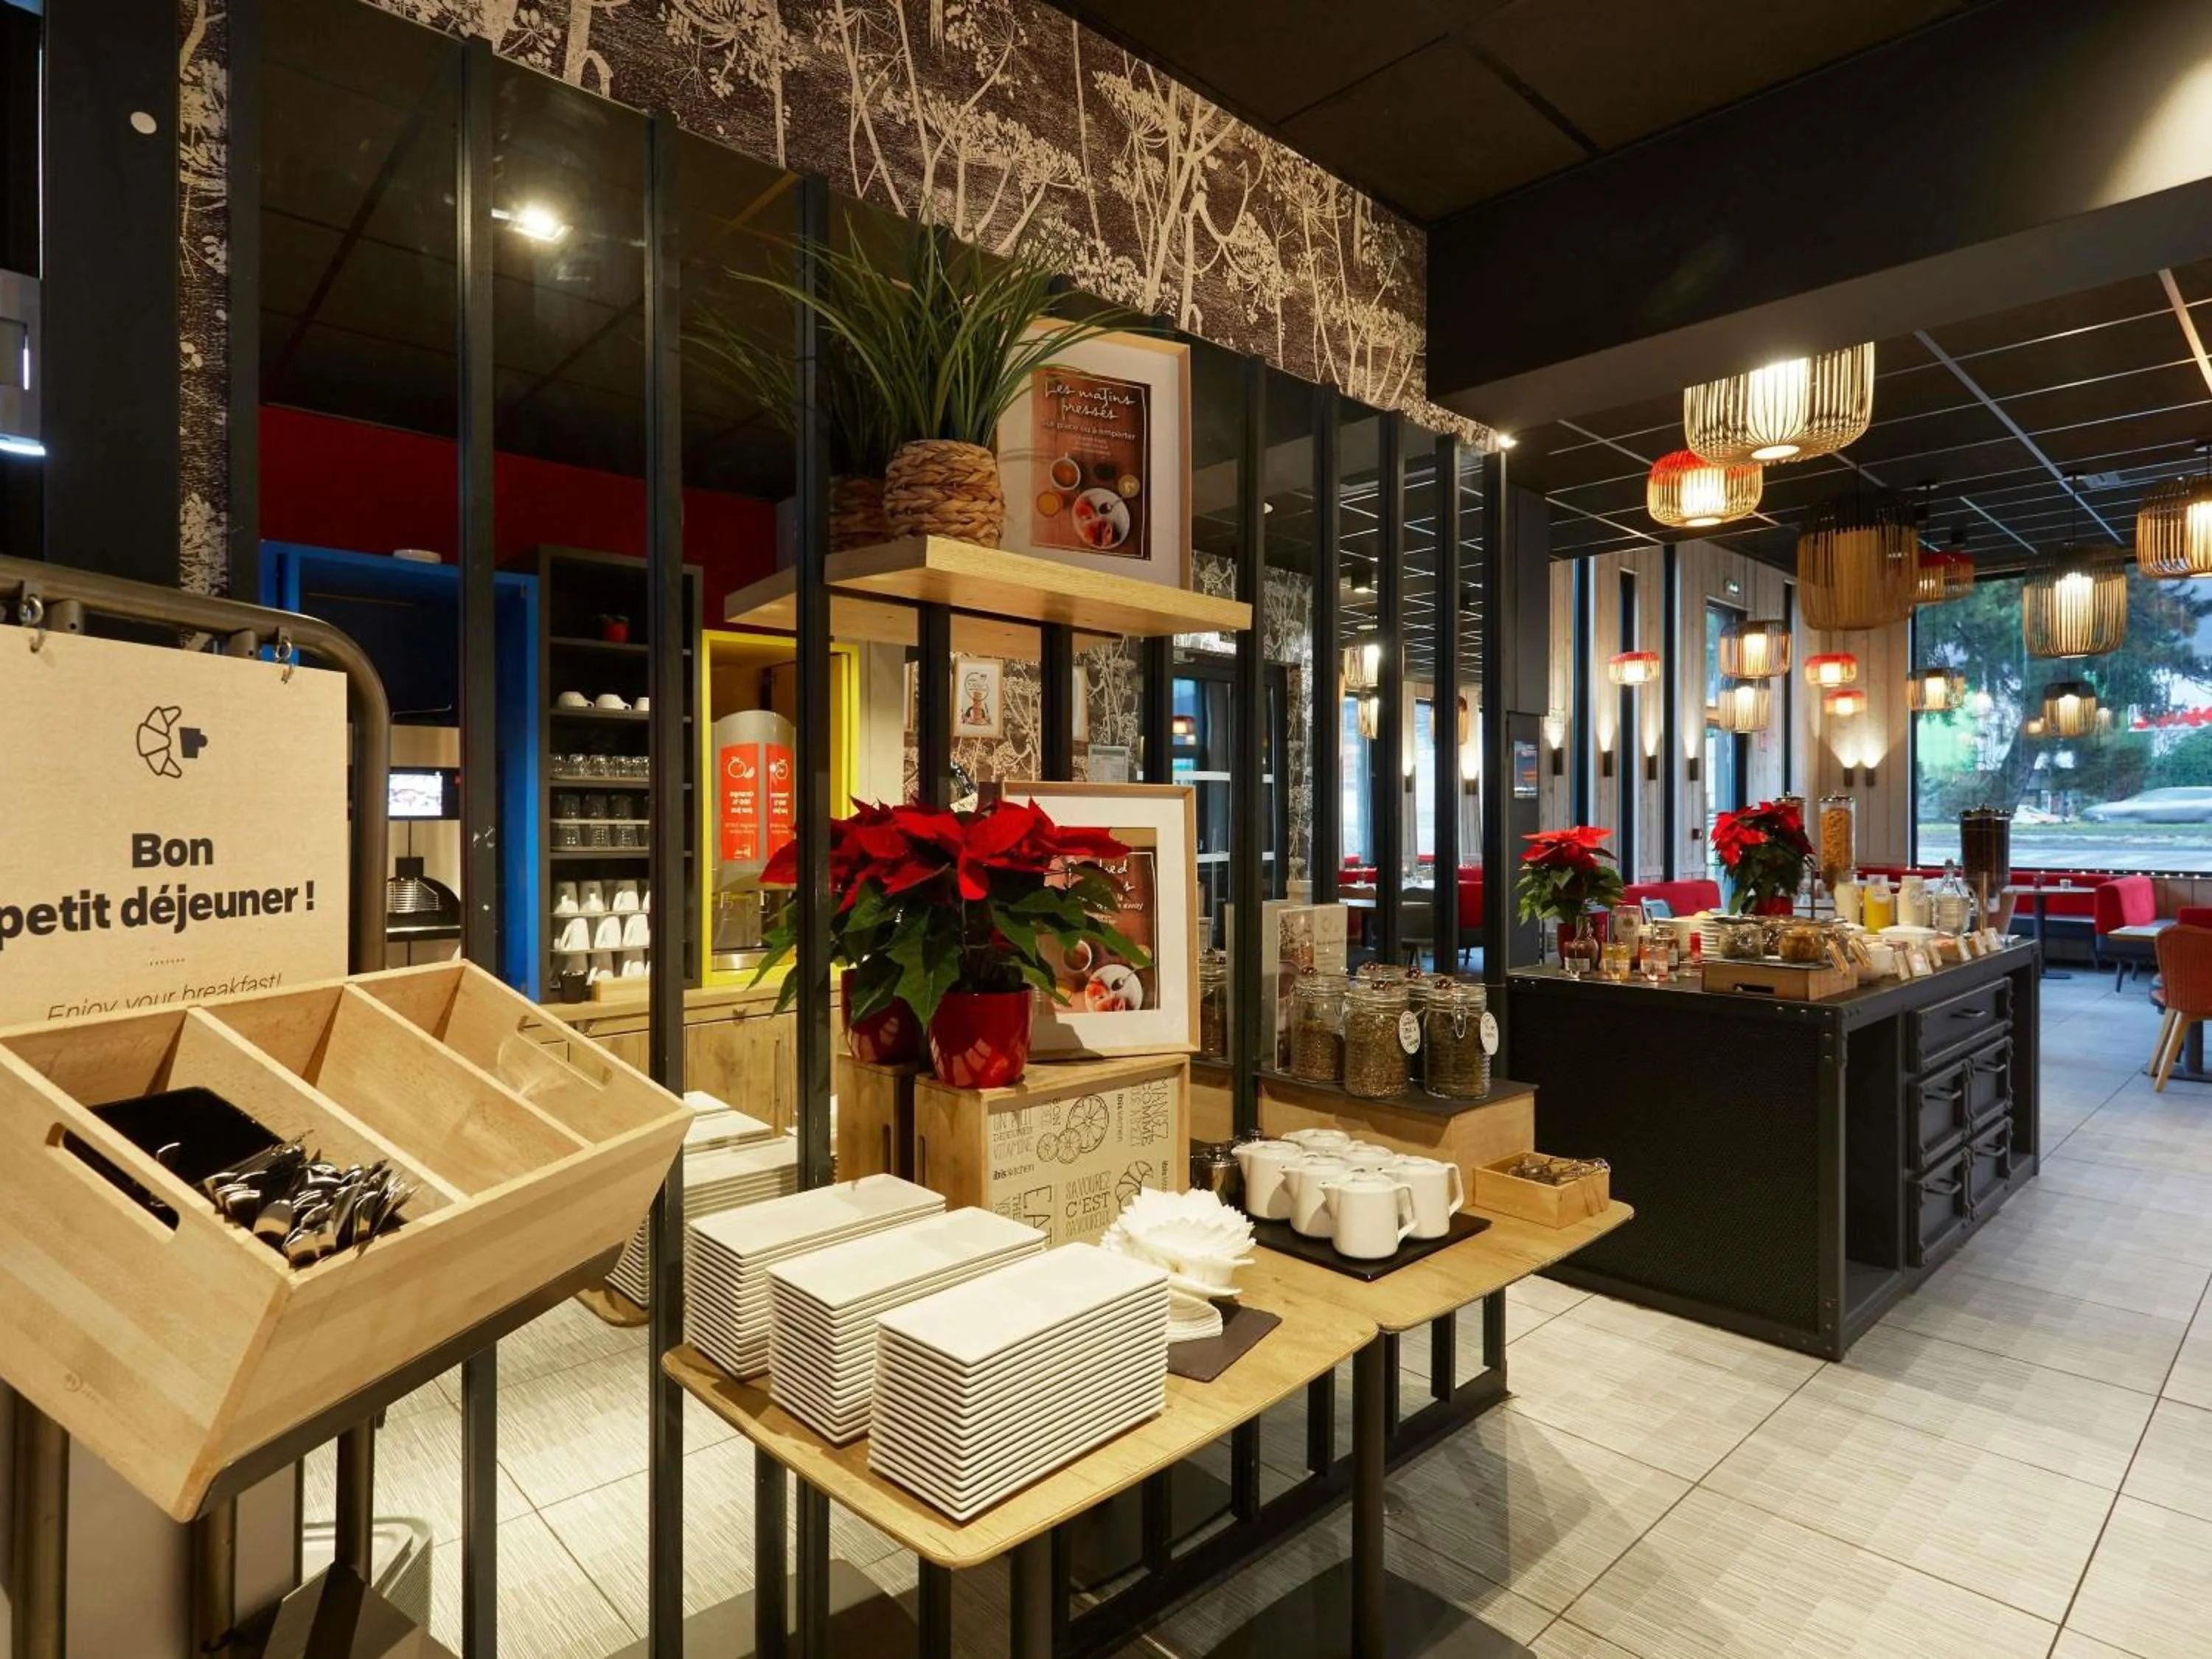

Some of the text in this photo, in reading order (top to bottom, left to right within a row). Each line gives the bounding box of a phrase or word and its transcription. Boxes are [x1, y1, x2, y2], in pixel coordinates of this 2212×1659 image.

[1045, 379, 1135, 407] Les matins
[132, 832, 214, 868] Bon
[0, 881, 315, 951] petit déjeuner !
[1065, 1191, 1110, 1217] C'EST
